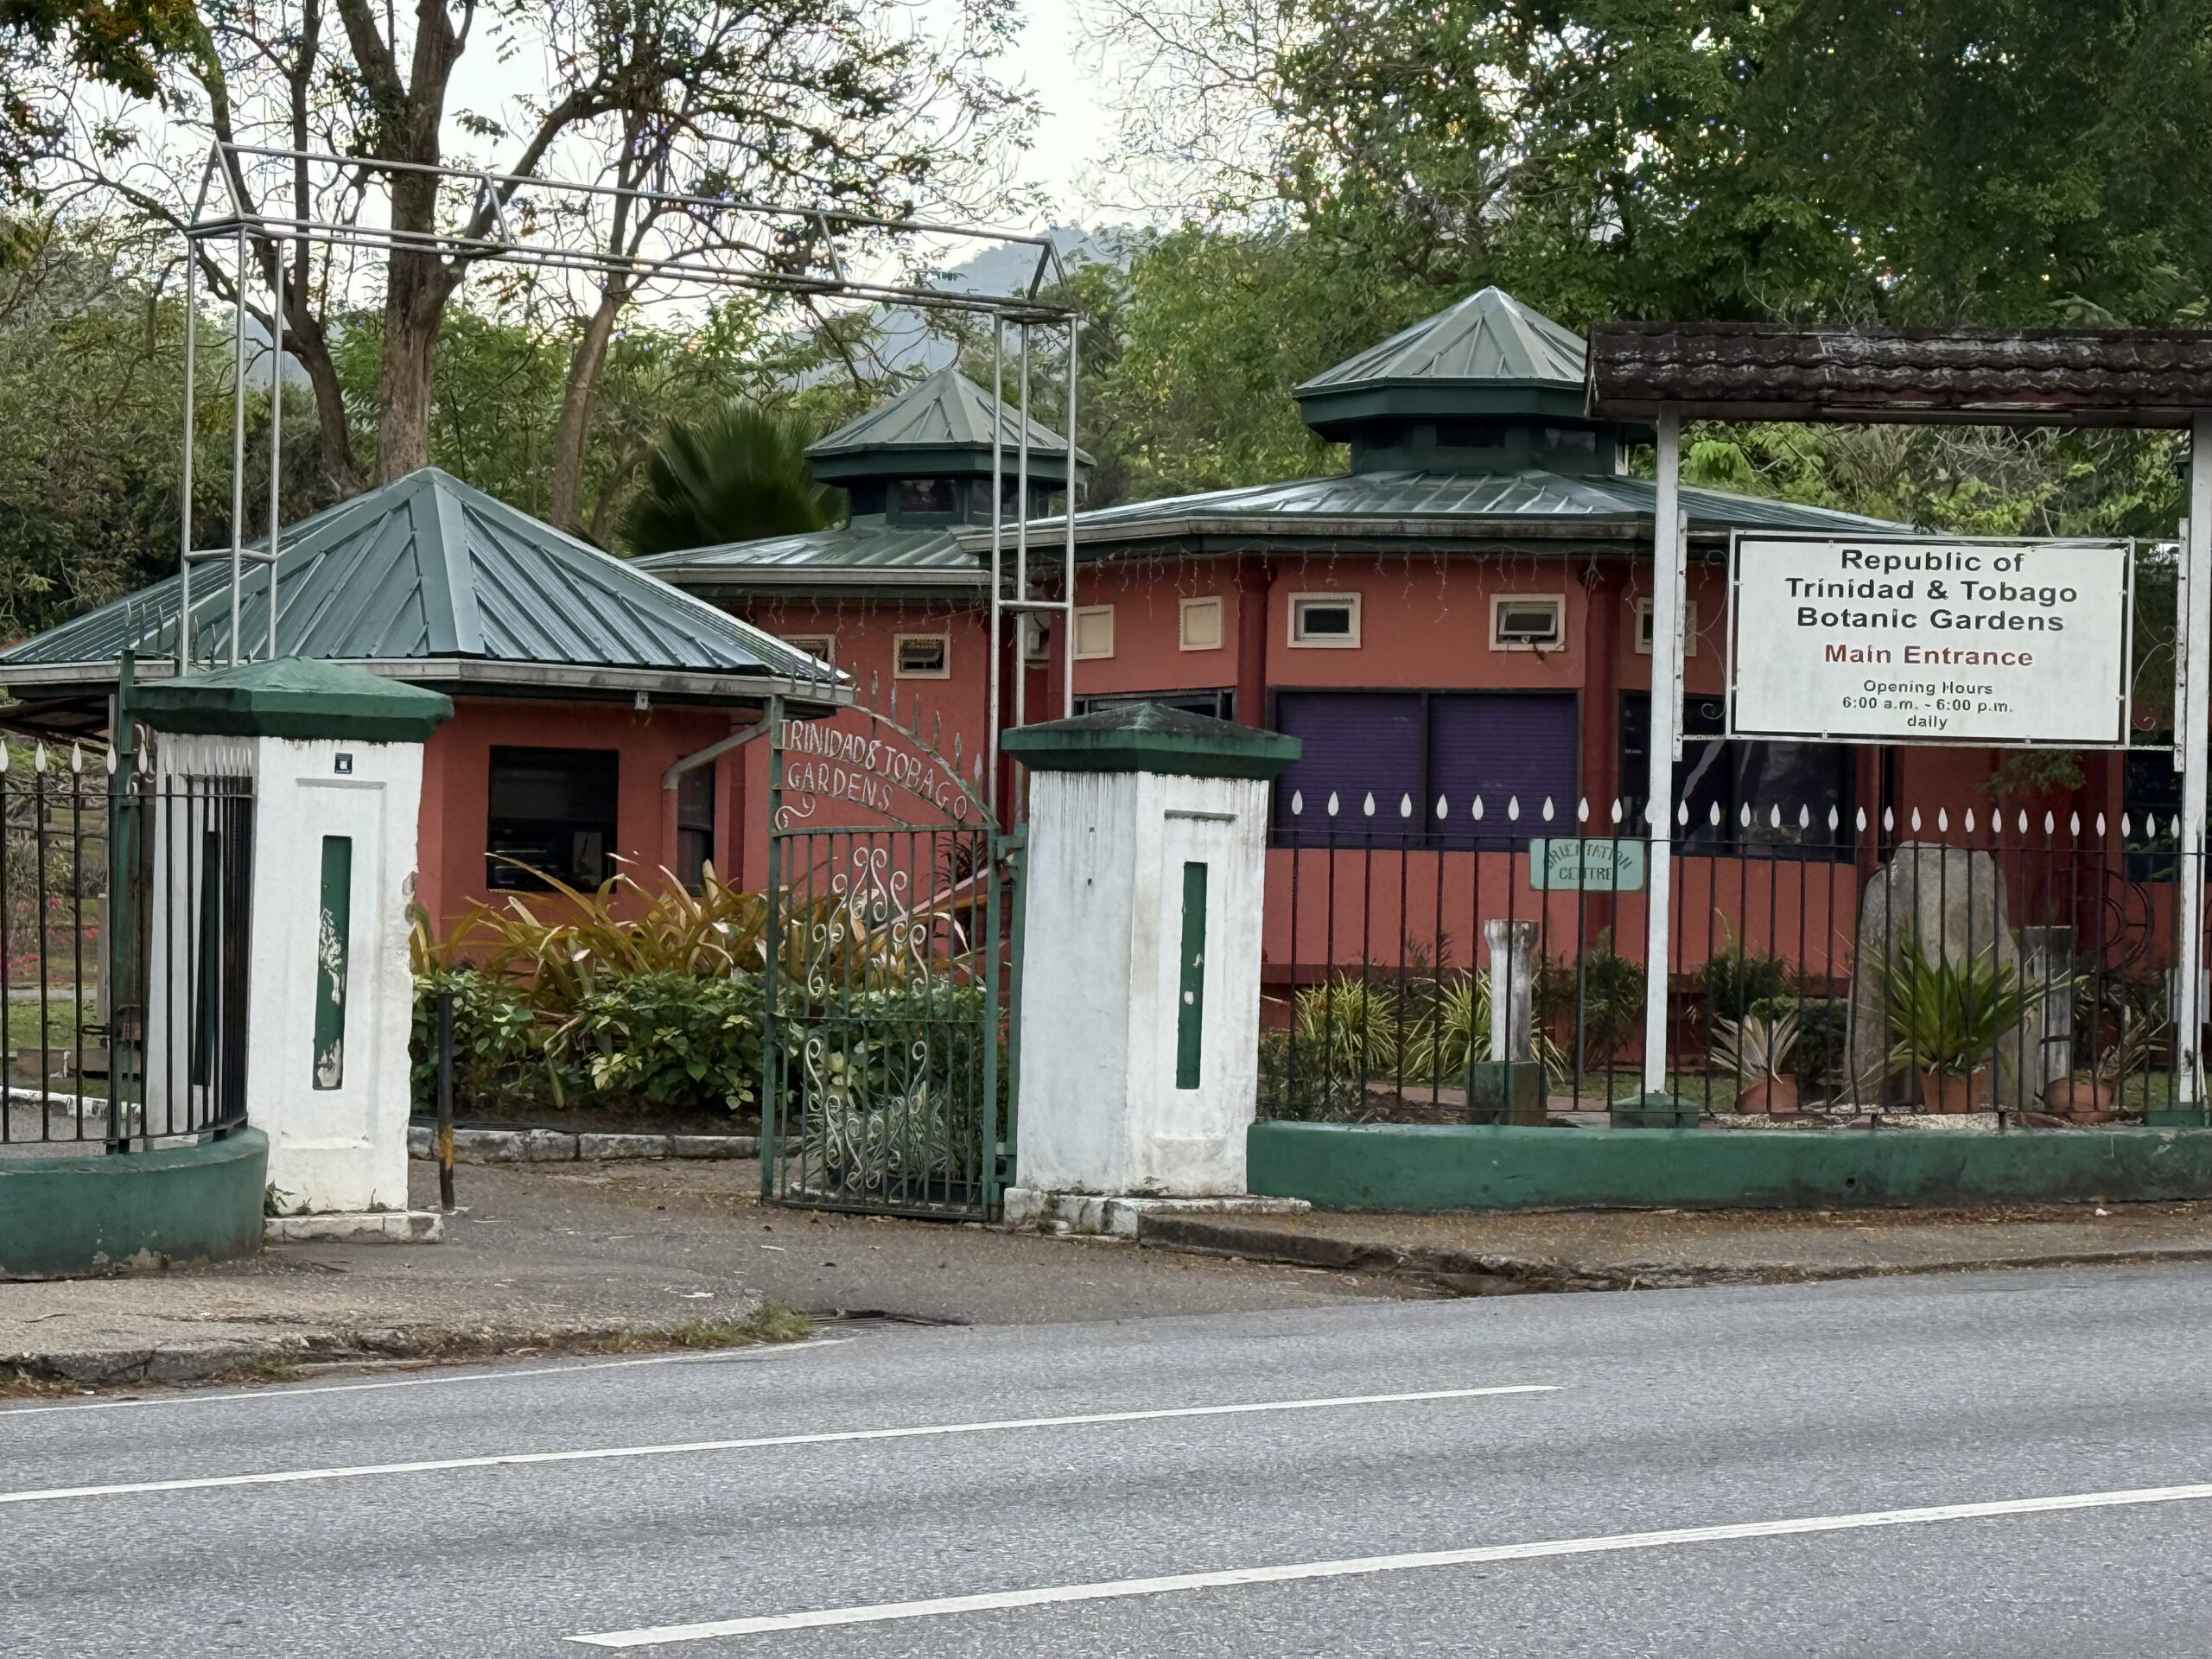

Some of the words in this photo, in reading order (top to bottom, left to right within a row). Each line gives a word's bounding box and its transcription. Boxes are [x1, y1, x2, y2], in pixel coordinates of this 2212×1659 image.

[1841, 549, 1981, 575] Republic
[1993, 553, 2024, 572] of
[1784, 577, 1914, 599] Trinidad
[1927, 580, 1948, 600] &
[1960, 581, 2077, 607] Tobago
[1797, 607, 1917, 628] Botanic
[1930, 609, 2064, 631] Gardens
[1825, 644, 1891, 663] Main
[1904, 645, 2033, 666] Entrance
[1864, 679, 1936, 696] Opening
[1942, 681, 1993, 694] Hours
[1842, 696, 1878, 709] 6:00
[1884, 699, 1918, 710] a.m.
[1936, 698, 1971, 711] 6:00
[1977, 702, 2012, 714] p.m.
[1907, 715, 1948, 730] daily
[779, 719, 866, 764] TRINIDAD
[885, 746, 968, 821] TOBAGO
[787, 761, 893, 812] GARDENS
[1559, 867, 1613, 880] CETRE
